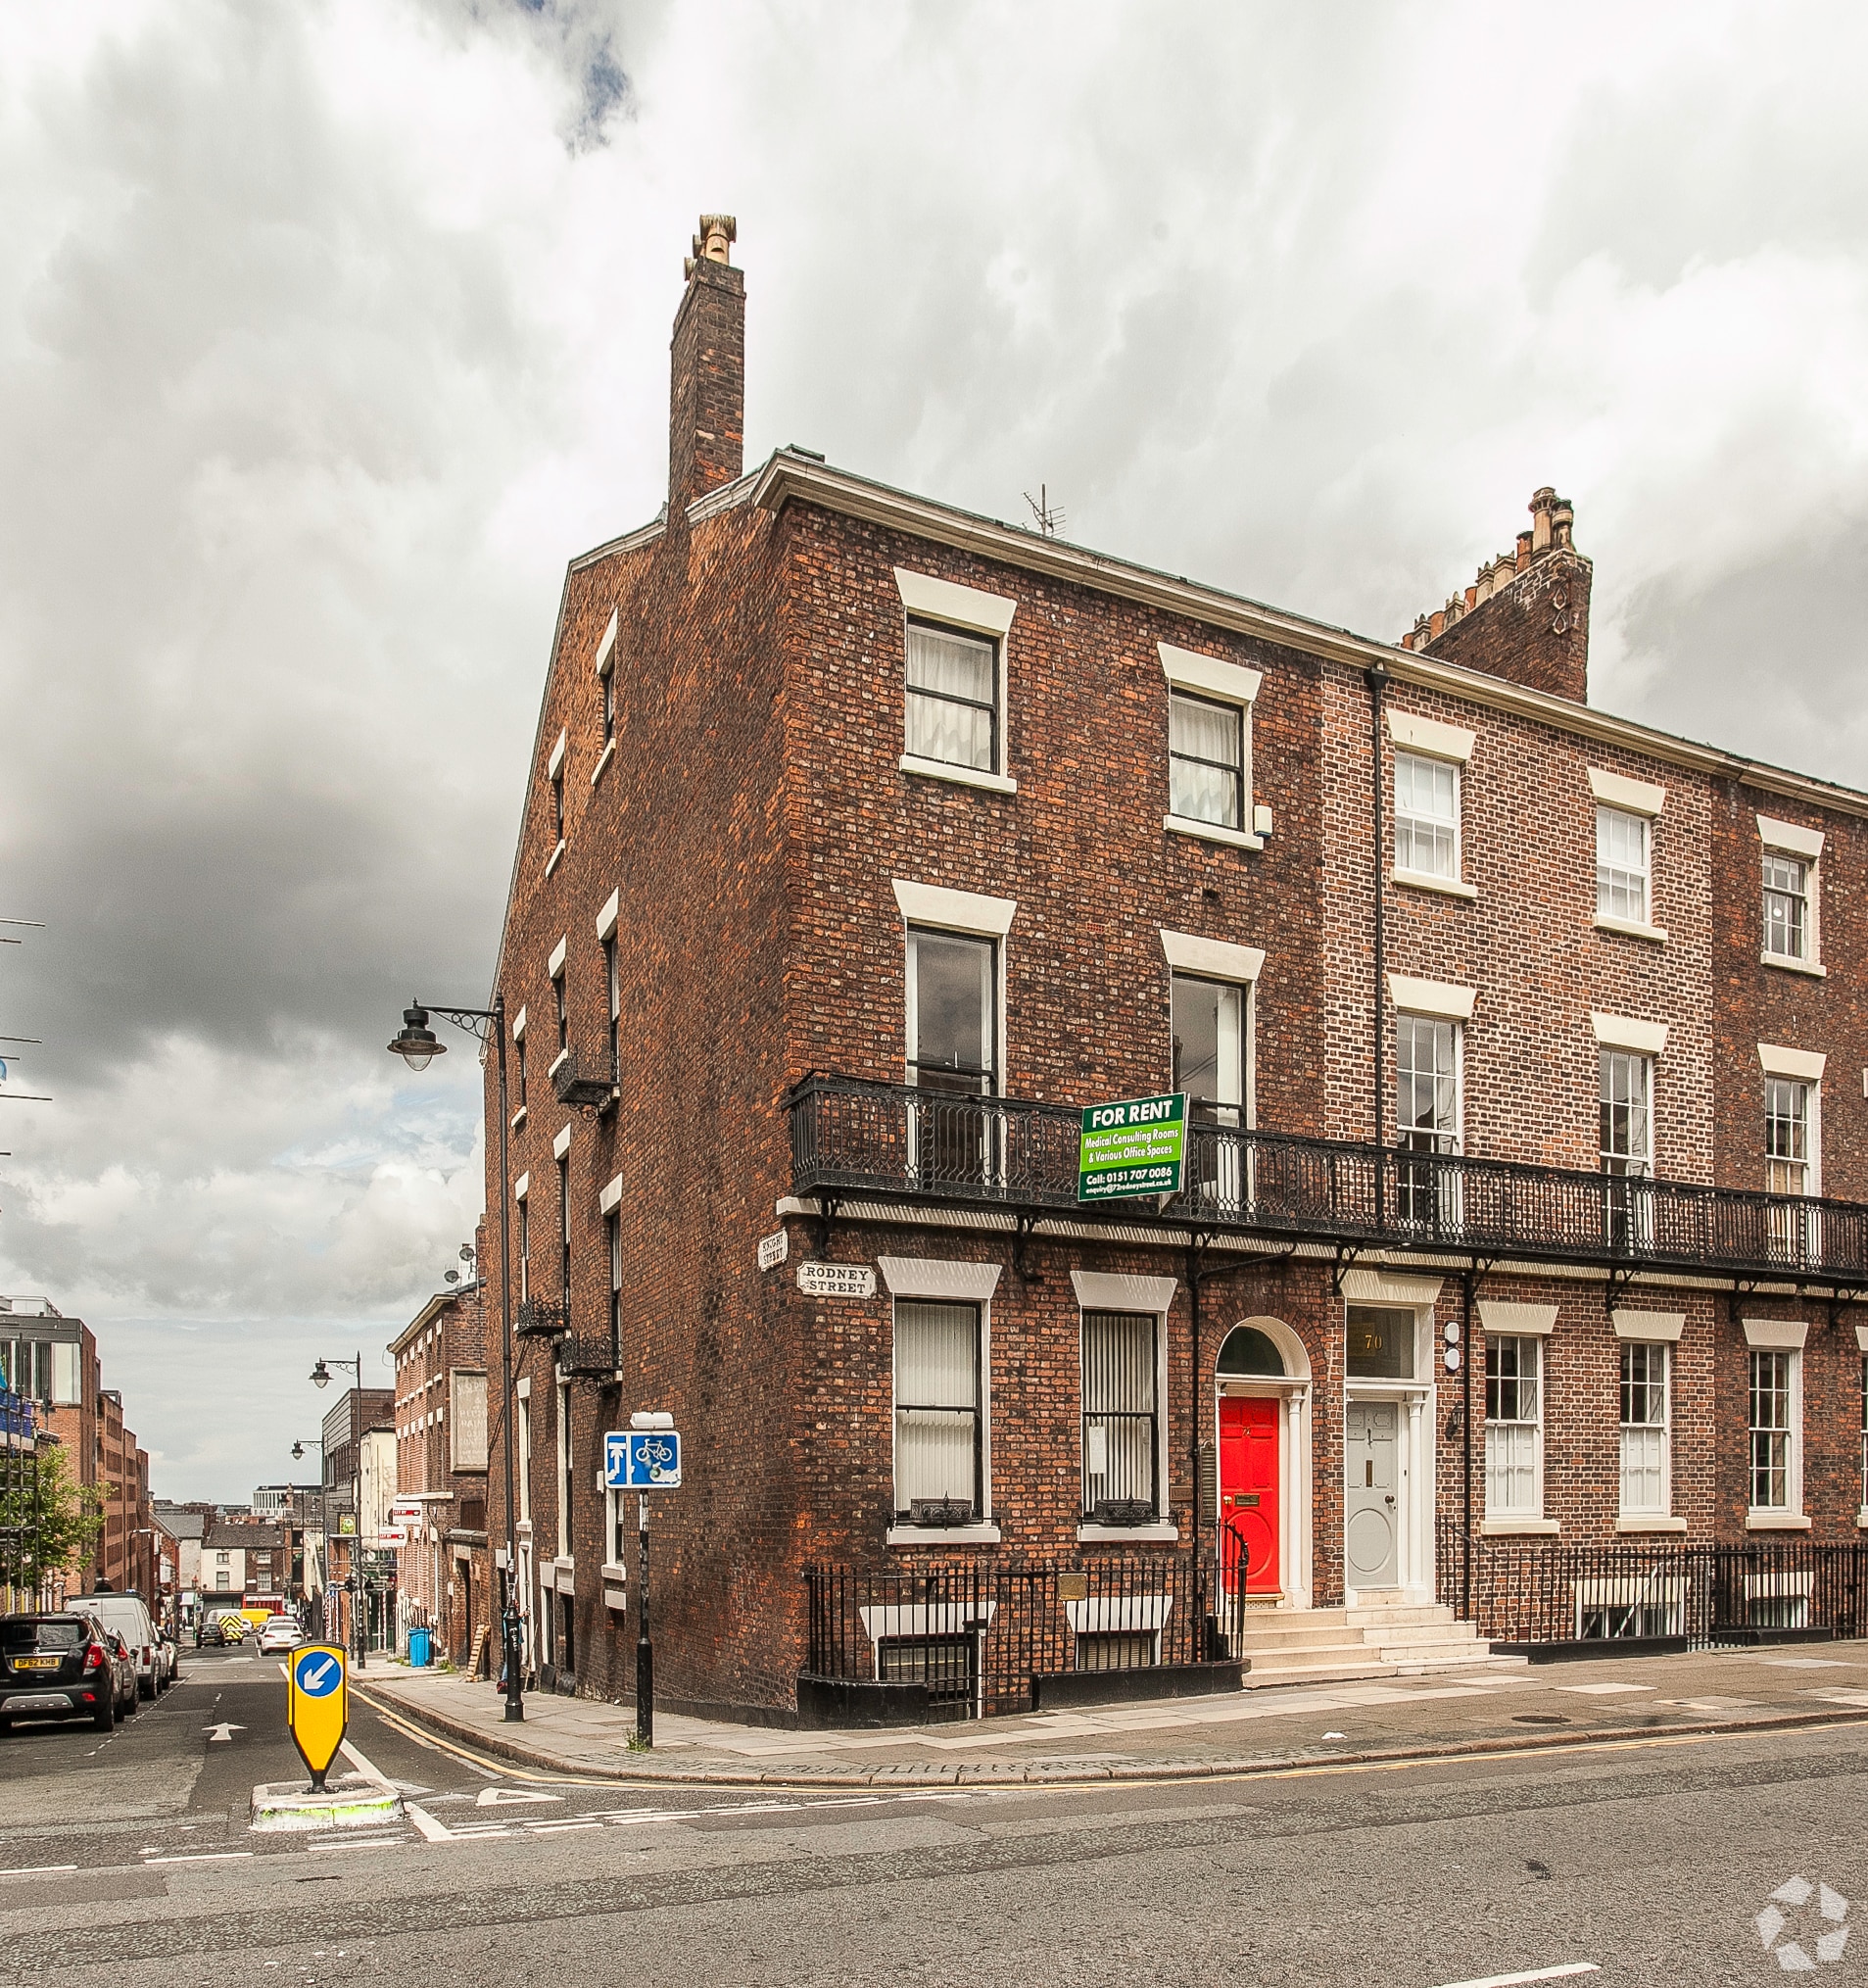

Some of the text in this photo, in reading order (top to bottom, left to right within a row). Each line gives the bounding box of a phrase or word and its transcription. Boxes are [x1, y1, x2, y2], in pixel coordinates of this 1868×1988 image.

[1092, 1100, 1173, 1128] FOR RENT
[1084, 1129, 1178, 1149] Medical Consulting Rooms
[1088, 1143, 1173, 1164] & Various Office Spaces
[1086, 1166, 1173, 1186] Call: 0151 707 0086
[806, 1266, 869, 1281] RODNEY
[809, 1281, 866, 1293] STREET
[1365, 1334, 1383, 1349] 70
